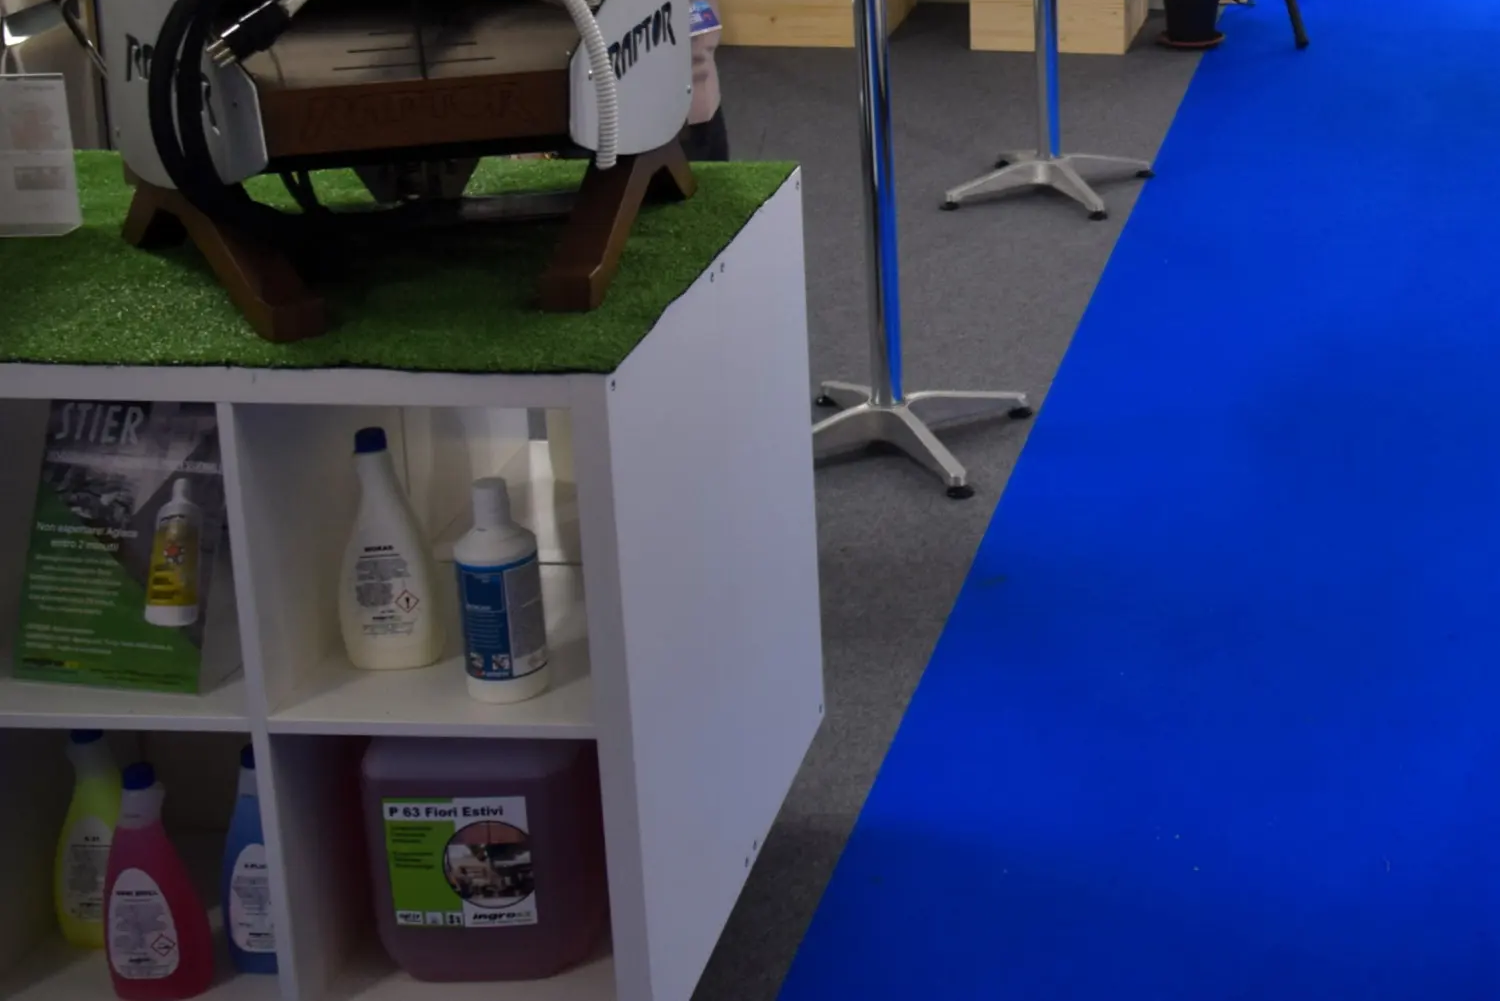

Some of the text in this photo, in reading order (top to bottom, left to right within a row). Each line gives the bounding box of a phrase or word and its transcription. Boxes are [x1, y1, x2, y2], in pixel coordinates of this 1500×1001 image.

[608, 1, 676, 80] RAPTOR
[55, 402, 144, 446] STIER
[389, 806, 505, 817] P 63 Fiori Estivi
